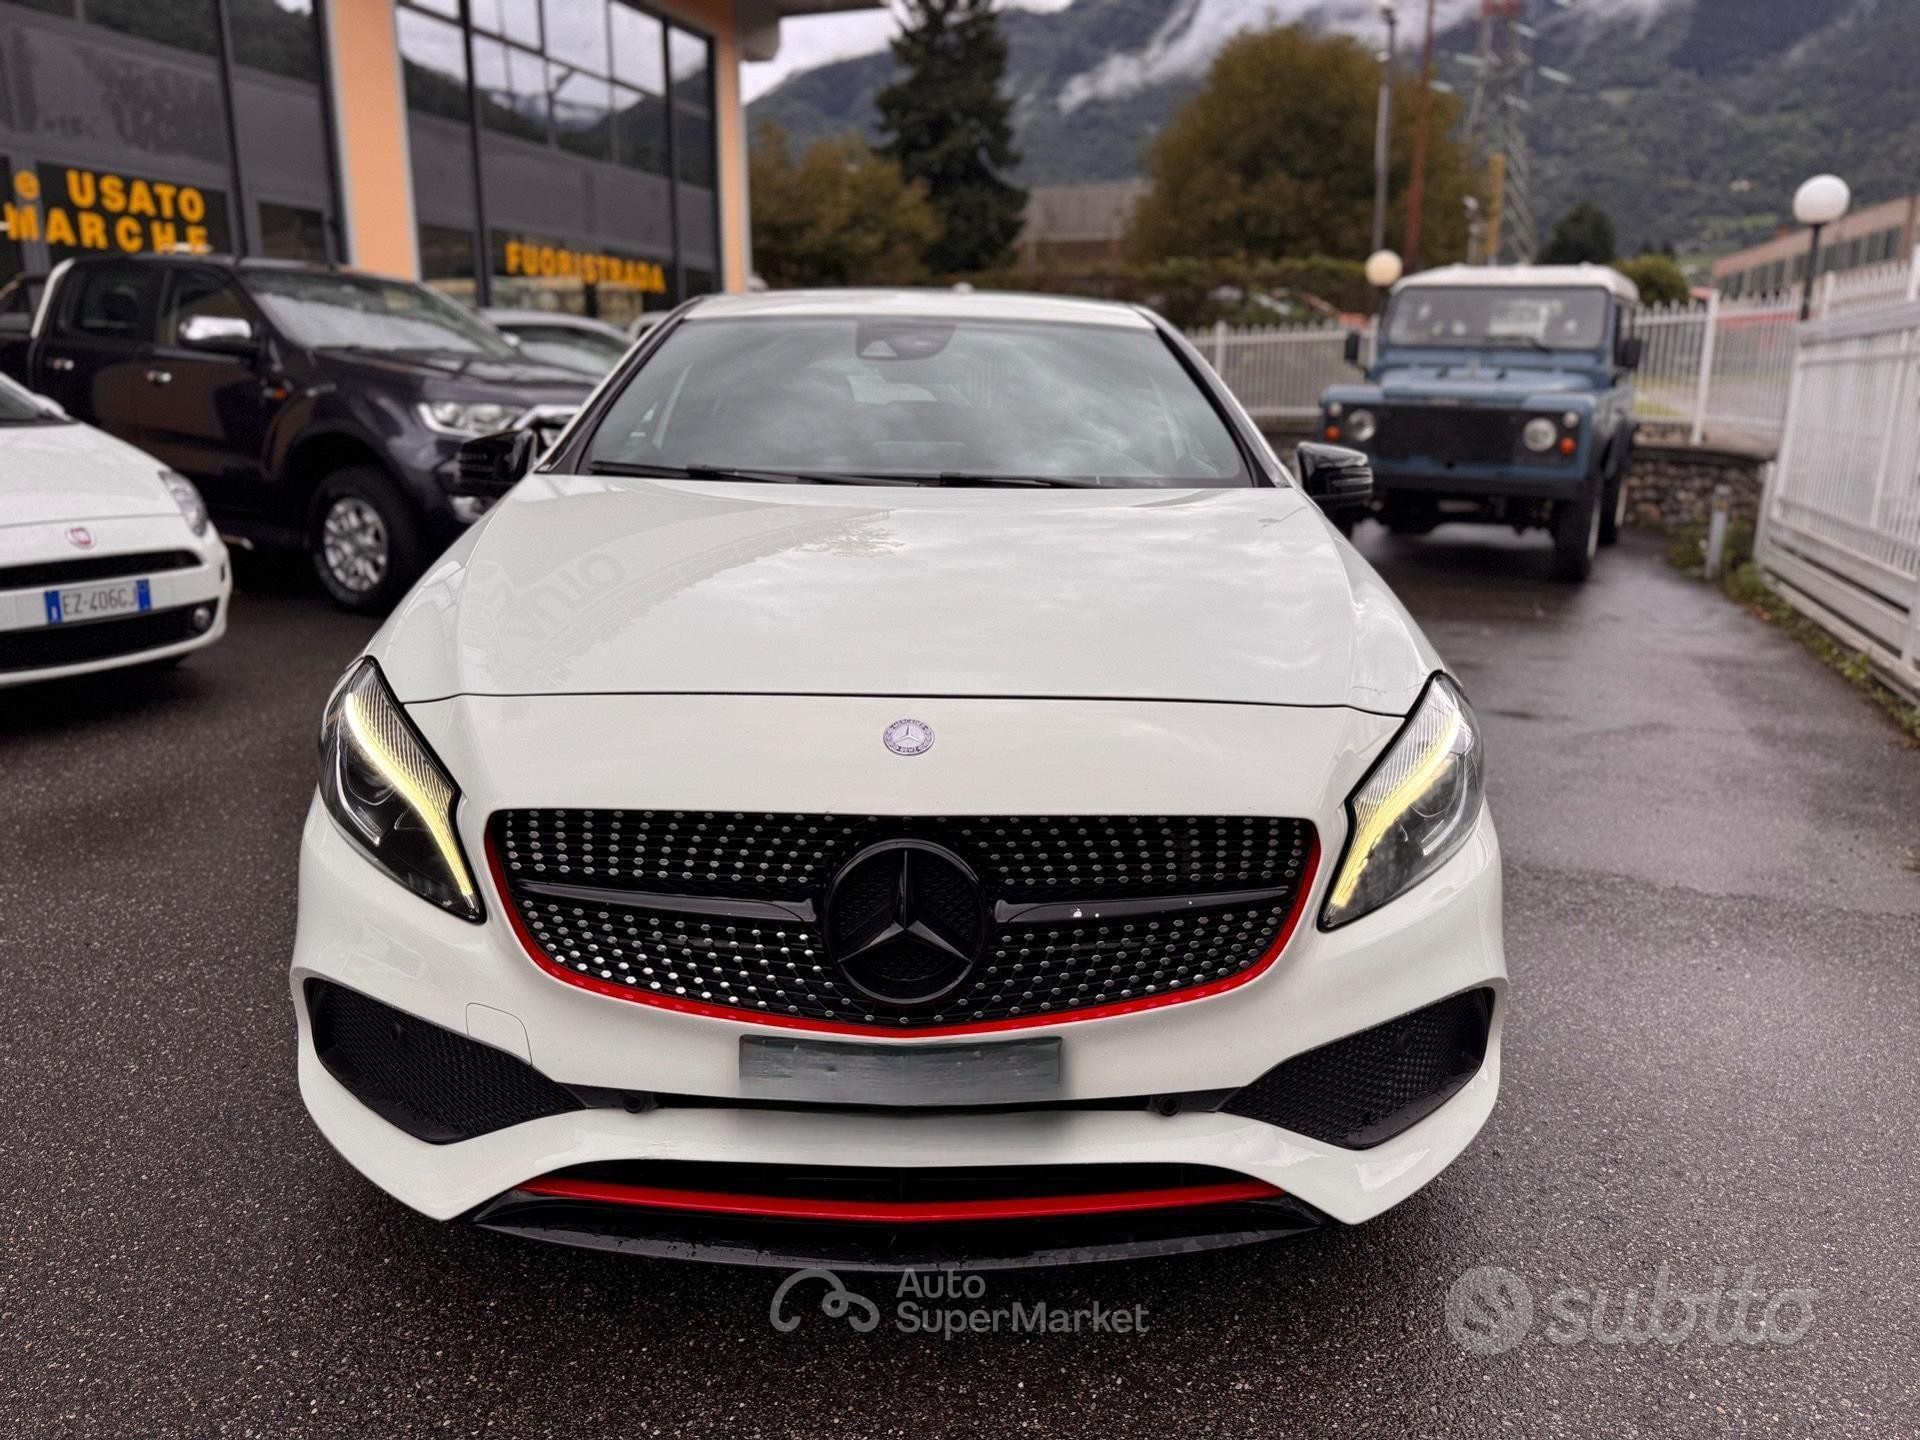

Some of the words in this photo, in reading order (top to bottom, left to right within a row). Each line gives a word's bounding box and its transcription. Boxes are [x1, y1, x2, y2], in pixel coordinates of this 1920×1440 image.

[66, 169, 206, 223] USATO
[4, 202, 208, 255] MARCHE
[505, 241, 666, 293] FUORISTRADA
